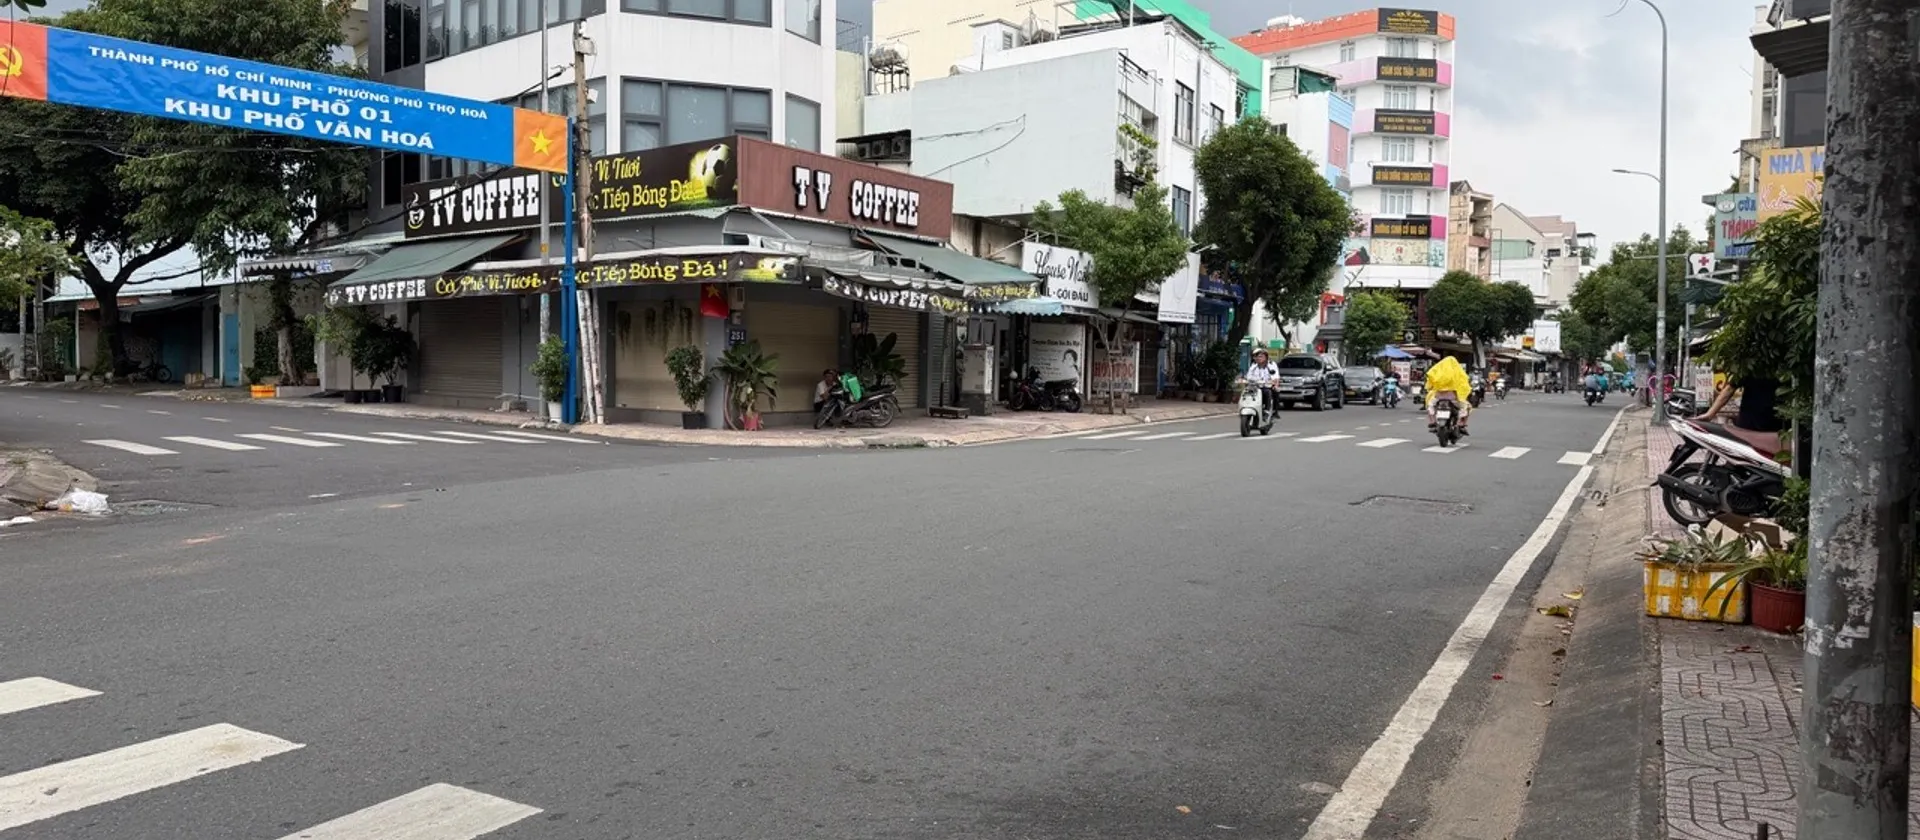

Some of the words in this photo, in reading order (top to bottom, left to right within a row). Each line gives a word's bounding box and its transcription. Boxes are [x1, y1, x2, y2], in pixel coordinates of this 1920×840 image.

[88, 46, 154, 65] THÀNH
[161, 58, 200, 72] PHỐ
[235, 70, 265, 84] CHÍ
[270, 76, 312, 92] MINH
[328, 85, 390, 104] PHƯỜNG
[427, 102, 456, 116] THỌ
[217, 83, 281, 107] KHU
[292, 94, 353, 117] PHỐ
[360, 106, 393, 124] 01
[165, 97, 231, 121] KHU
[243, 109, 309, 131] PHỐ
[315, 119, 372, 140] VĂN
[381, 130, 434, 149] HOÁ
[1768, 149, 1805, 175] NHÀ
[429, 185, 456, 227] TV
[462, 174, 539, 223] COFFEE
[602, 184, 630, 212] Tiếp
[632, 183, 667, 208] Bóng
[851, 179, 920, 227] COFFEE
[630, 262, 676, 281] Bóng
[682, 259, 716, 278] Đá
[1034, 248, 1066, 279] House
[345, 286, 368, 303] TV
[370, 279, 426, 301] COFFEE
[869, 287, 928, 310] COFFEE
[730, 331, 744, 341] 251
